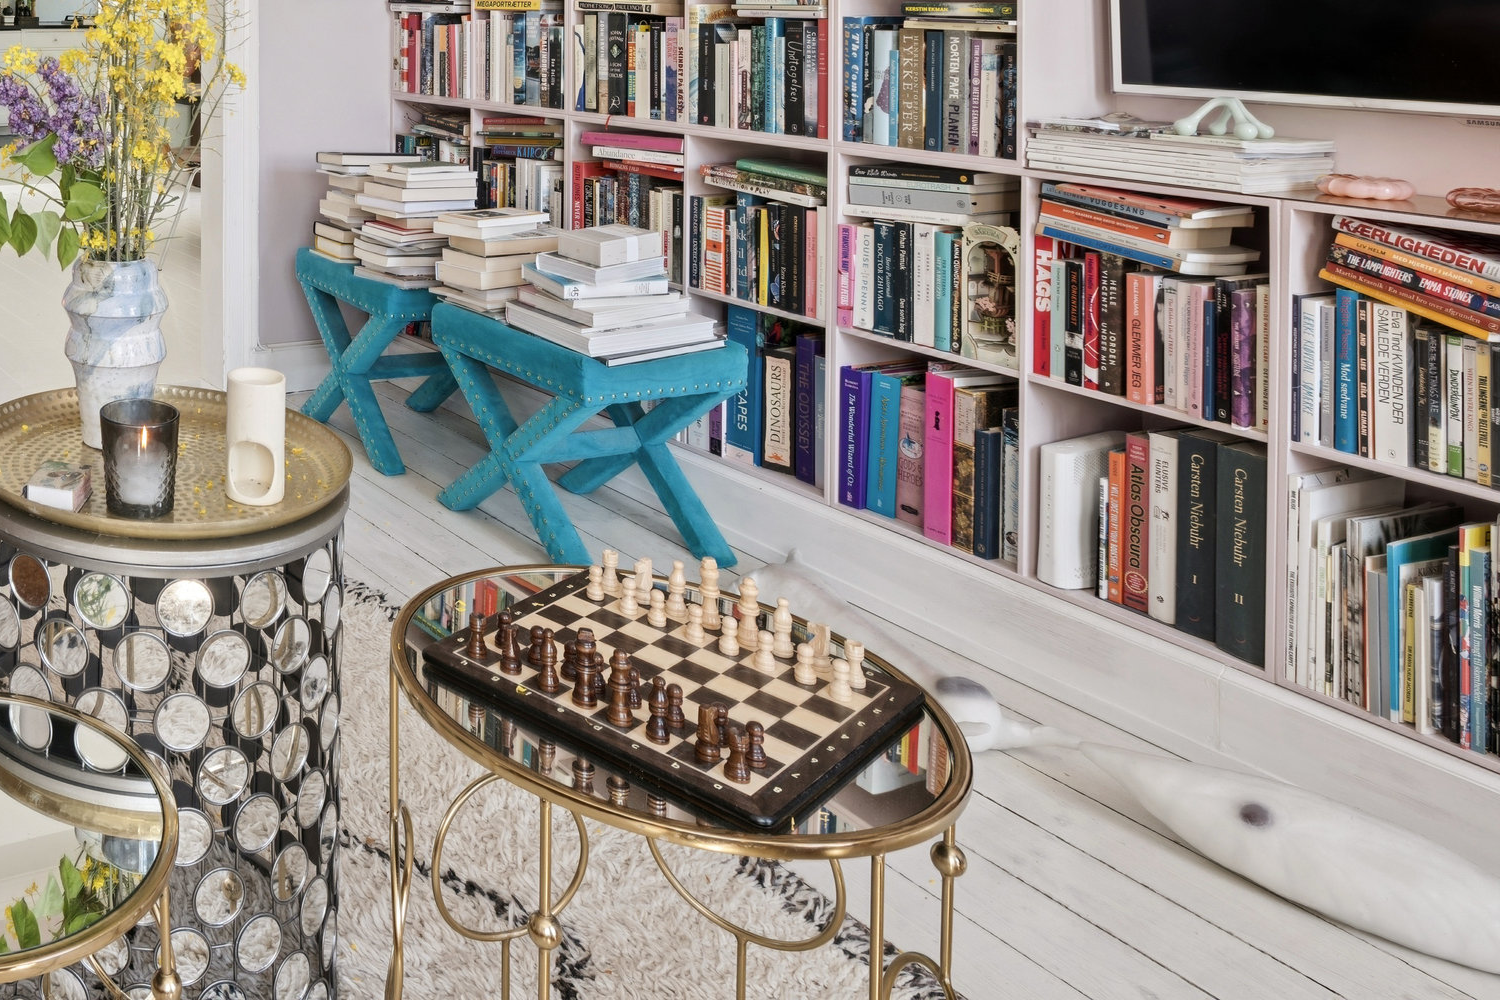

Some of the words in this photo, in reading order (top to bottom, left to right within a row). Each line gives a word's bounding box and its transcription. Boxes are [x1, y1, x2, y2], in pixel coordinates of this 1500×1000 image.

[476, 0, 532, 8] MEGAPORTRÆTTER
[851, 33, 860, 58] The
[949, 36, 960, 73] MORTEN
[786, 40, 803, 102] Undtagelsen
[902, 34, 913, 132] LYKKE-PER
[949, 76, 960, 99] PAPE
[850, 64, 860, 116] Coming
[947, 104, 960, 146] PLANEN
[517, 147, 547, 159] KAIROS
[597, 148, 636, 159] Abundance
[1089, 197, 1145, 217] VUGGESANG
[862, 234, 870, 268] LOUISE
[1339, 217, 1487, 274] KÆRLIGHEDEN
[1036, 249, 1052, 313] HAGS
[1347, 253, 1361, 266] THE
[1361, 258, 1414, 284] LAMPLIGHTERS
[1418, 278, 1442, 293] EMMA
[860, 279, 868, 313] PENNY
[1070, 284, 1078, 326] ORIENTALIST
[1109, 280, 1117, 306] HELLE
[1335, 267, 1358, 281] Martin
[1358, 274, 1384, 289] Krasnik
[1388, 284, 1397, 293] En
[1399, 287, 1414, 299] smal
[1415, 295, 1428, 305] bro
[1429, 302, 1443, 311] over
[1444, 306, 1481, 324] afgrunden
[1377, 308, 1389, 359] SAMLEDE
[1391, 310, 1402, 329] Eva
[1109, 331, 1117, 366] JORDEN
[1131, 318, 1142, 369] GLEMMER
[1391, 331, 1403, 352] Tind
[798, 363, 809, 388] THE
[1131, 370, 1142, 388] JEG
[1340, 362, 1351, 382] Mod
[1378, 359, 1390, 404] VERDEN
[1392, 353, 1404, 402] KVINDEN
[770, 365, 781, 443] DINOSAURS
[848, 393, 856, 405] The
[1340, 383, 1351, 419] sædvane
[1392, 402, 1404, 425] DER
[798, 393, 810, 454] ODYSSEY
[847, 406, 855, 442] Wonderful
[846, 443, 855, 468] Wizard
[846, 468, 854, 476] of
[847, 476, 854, 487] Oz
[1130, 463, 1145, 502] Atlas
[1189, 453, 1205, 500] Carsten
[1234, 468, 1248, 514] Carsten
[1129, 504, 1145, 569] Obscura
[1189, 501, 1205, 552] Niebuhr
[1233, 514, 1248, 568] Niebuhr
